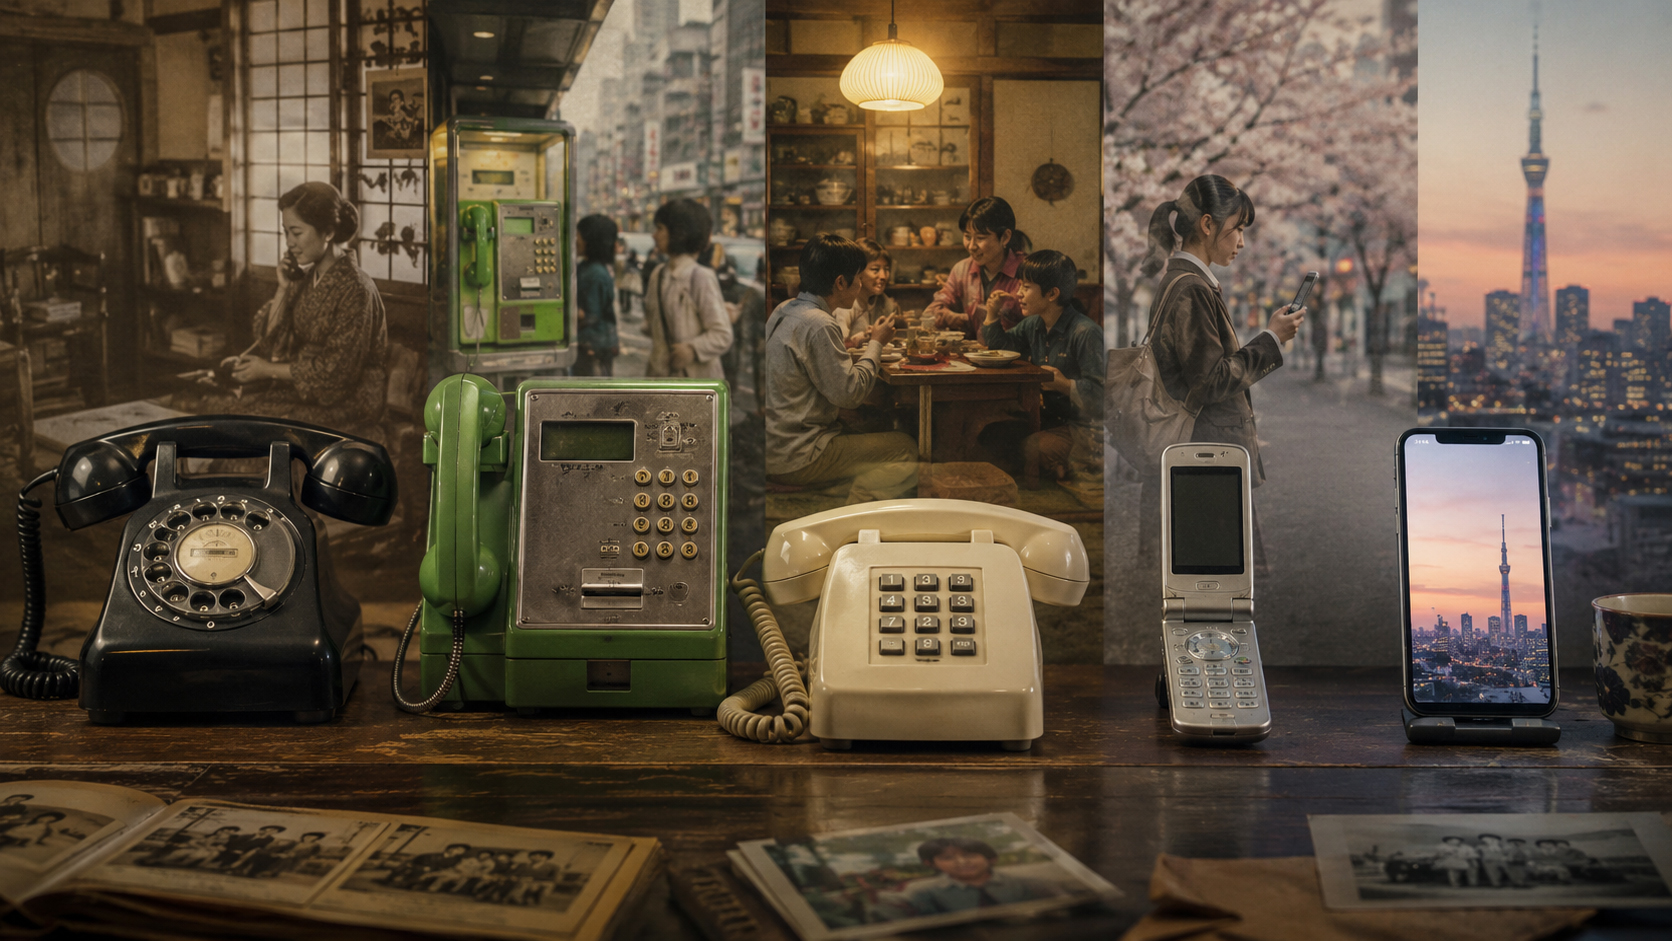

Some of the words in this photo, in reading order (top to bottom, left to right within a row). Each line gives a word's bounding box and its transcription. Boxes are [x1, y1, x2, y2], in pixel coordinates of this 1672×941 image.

[888, 575, 894, 584] 1
[886, 595, 896, 605] 4
[888, 617, 896, 627] 7
[922, 616, 932, 626] 2
